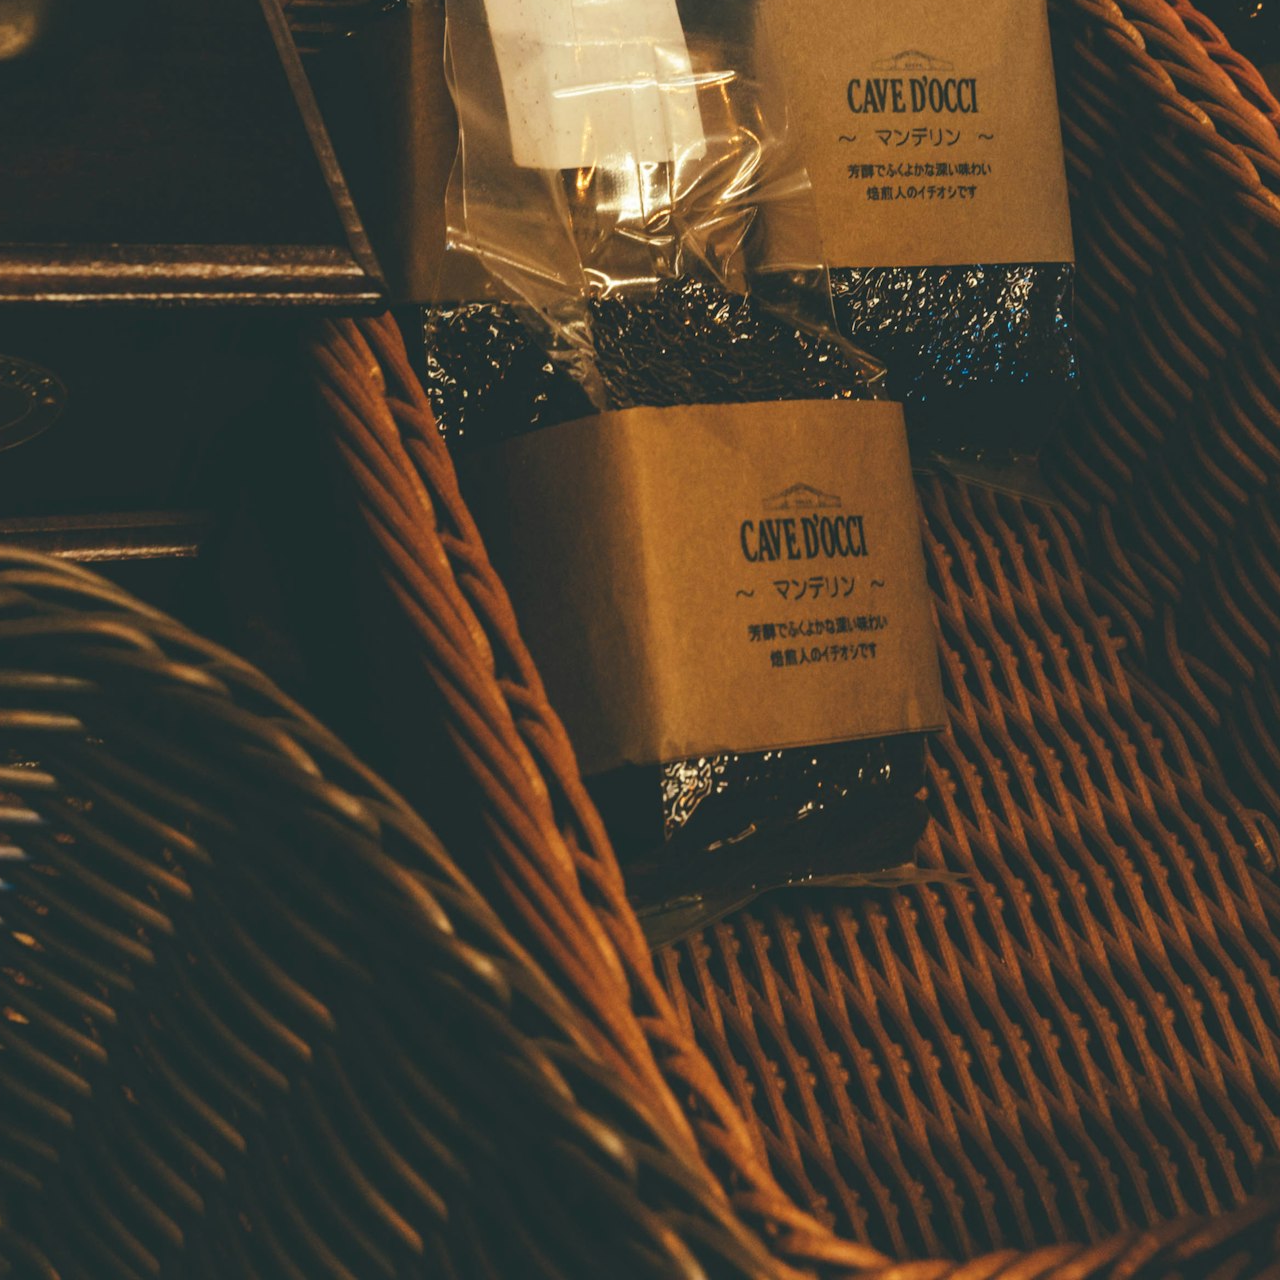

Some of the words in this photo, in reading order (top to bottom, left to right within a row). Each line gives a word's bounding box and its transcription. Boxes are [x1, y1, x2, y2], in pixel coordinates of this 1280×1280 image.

[846, 77, 907, 115] CAVE
[874, 125, 962, 148] マンデリン
[846, 161, 993, 180] 芳醇でふくよかな深い味わい
[865, 184, 978, 202] 焙煎人のイチオシです
[739, 518, 802, 563] CAVE
[772, 575, 856, 602] マンデリン
